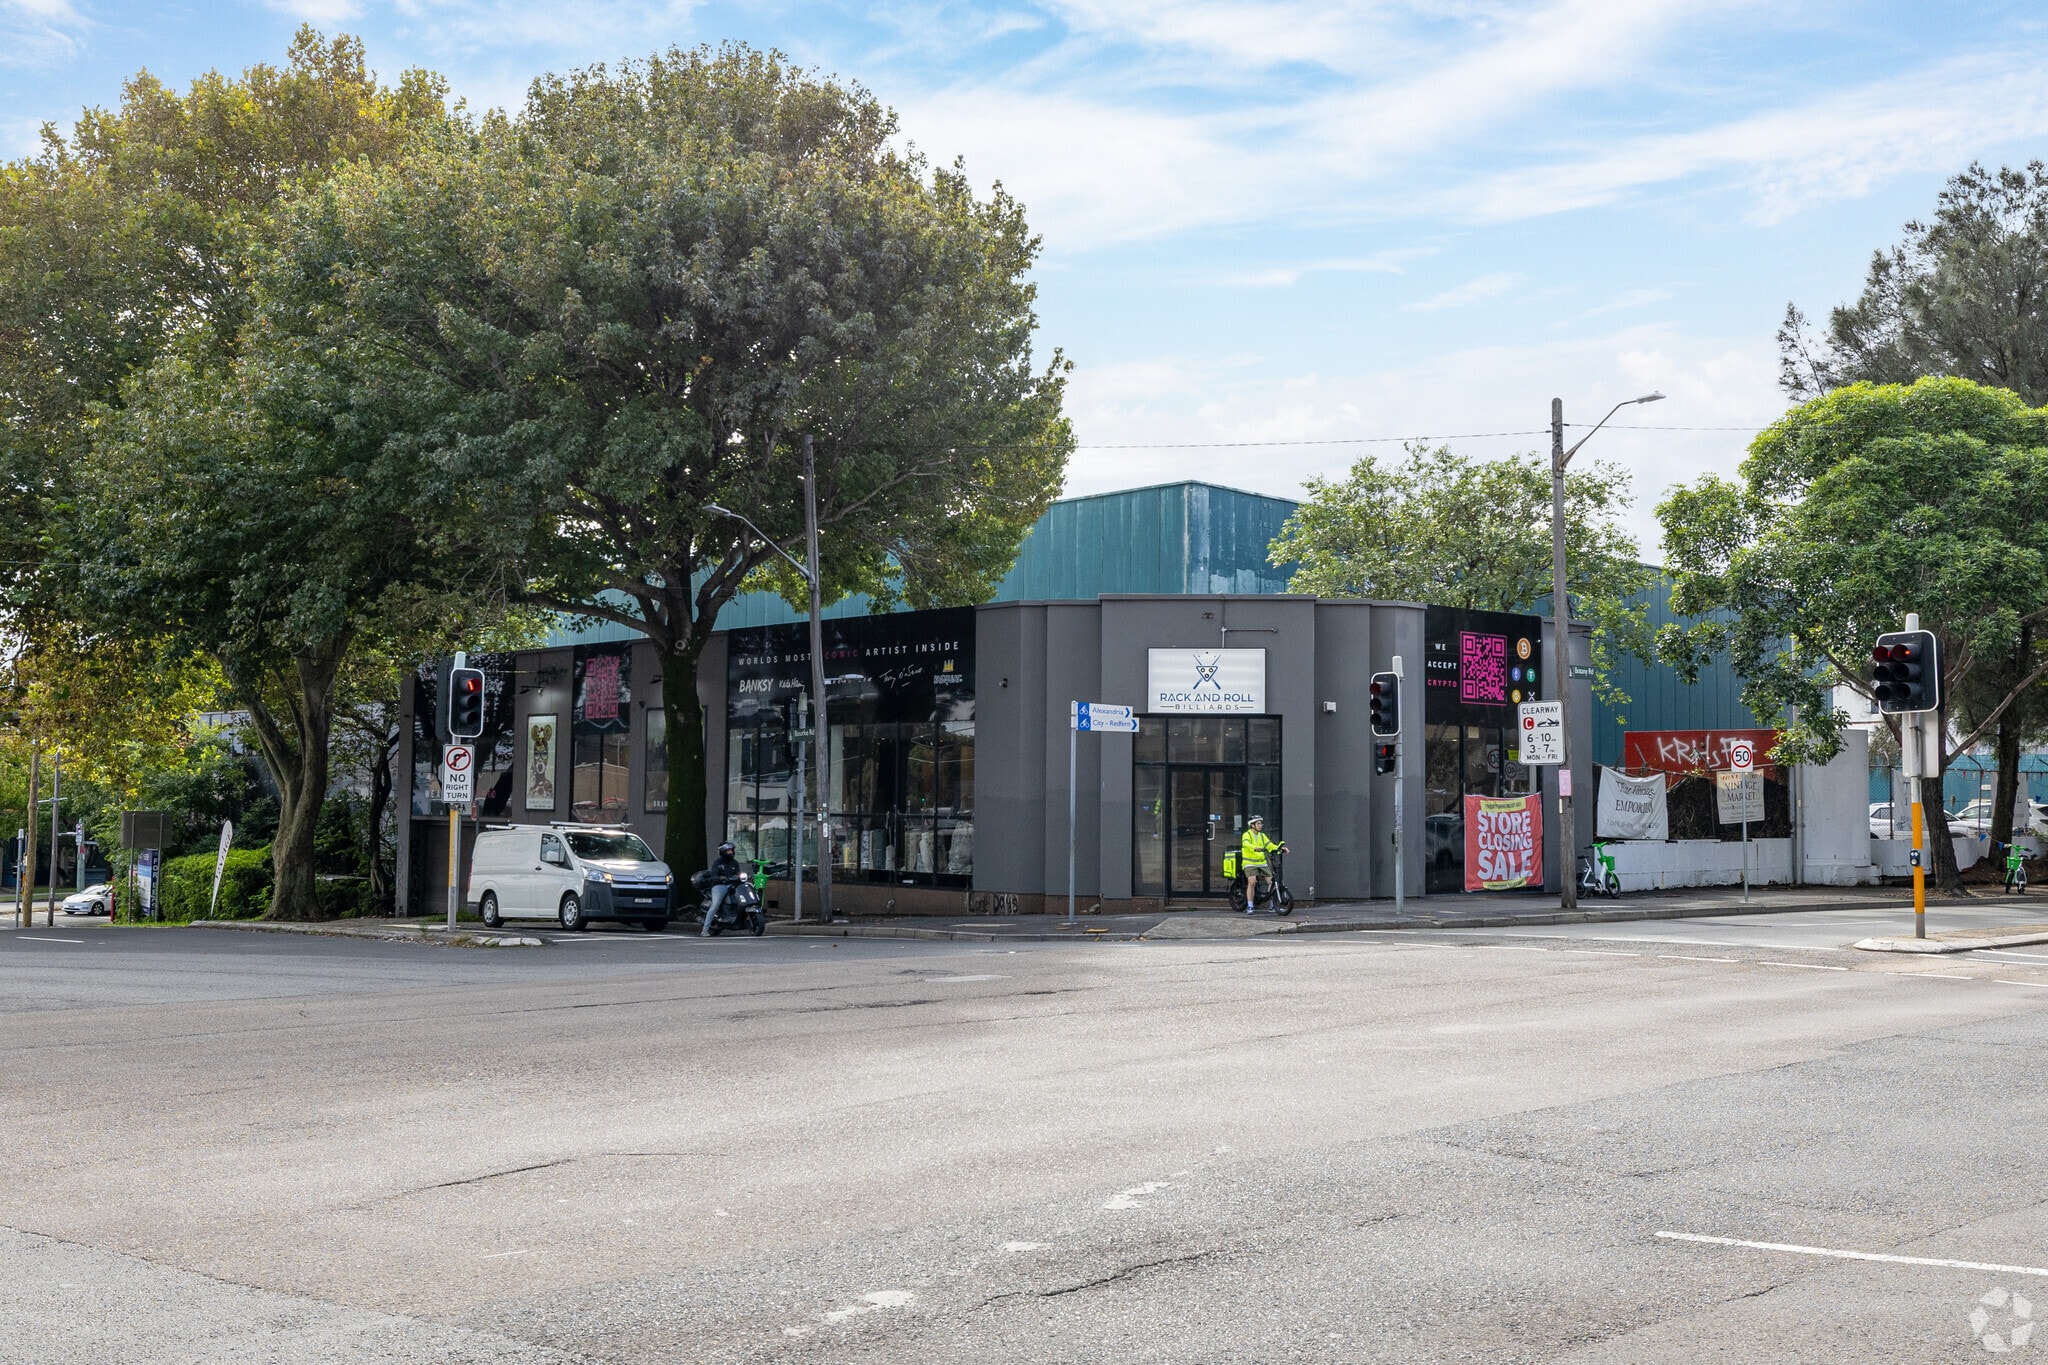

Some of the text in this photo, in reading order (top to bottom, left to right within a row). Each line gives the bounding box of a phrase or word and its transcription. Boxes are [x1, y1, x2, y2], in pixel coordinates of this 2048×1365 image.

[1435, 643, 1446, 651] WE
[738, 642, 959, 666] WORLDS MOST CONIC ARTIST INSIDE
[1428, 661, 1457, 670] ACCEPT
[739, 678, 774, 694] BANKSY
[1428, 679, 1457, 688] CRYPTO
[1160, 693, 1254, 702] RACK AND ROLL
[1092, 707, 1124, 715] Alexandria
[1522, 706, 1559, 715] CLEARWAY
[1525, 717, 1532, 729] C
[1735, 750, 1750, 762] 50
[450, 774, 466, 782] NO
[1727, 792, 1756, 802] MARKET
[1477, 810, 1532, 834] STORE
[1478, 832, 1533, 851] CLOSING
[1477, 849, 1534, 880] SALE
